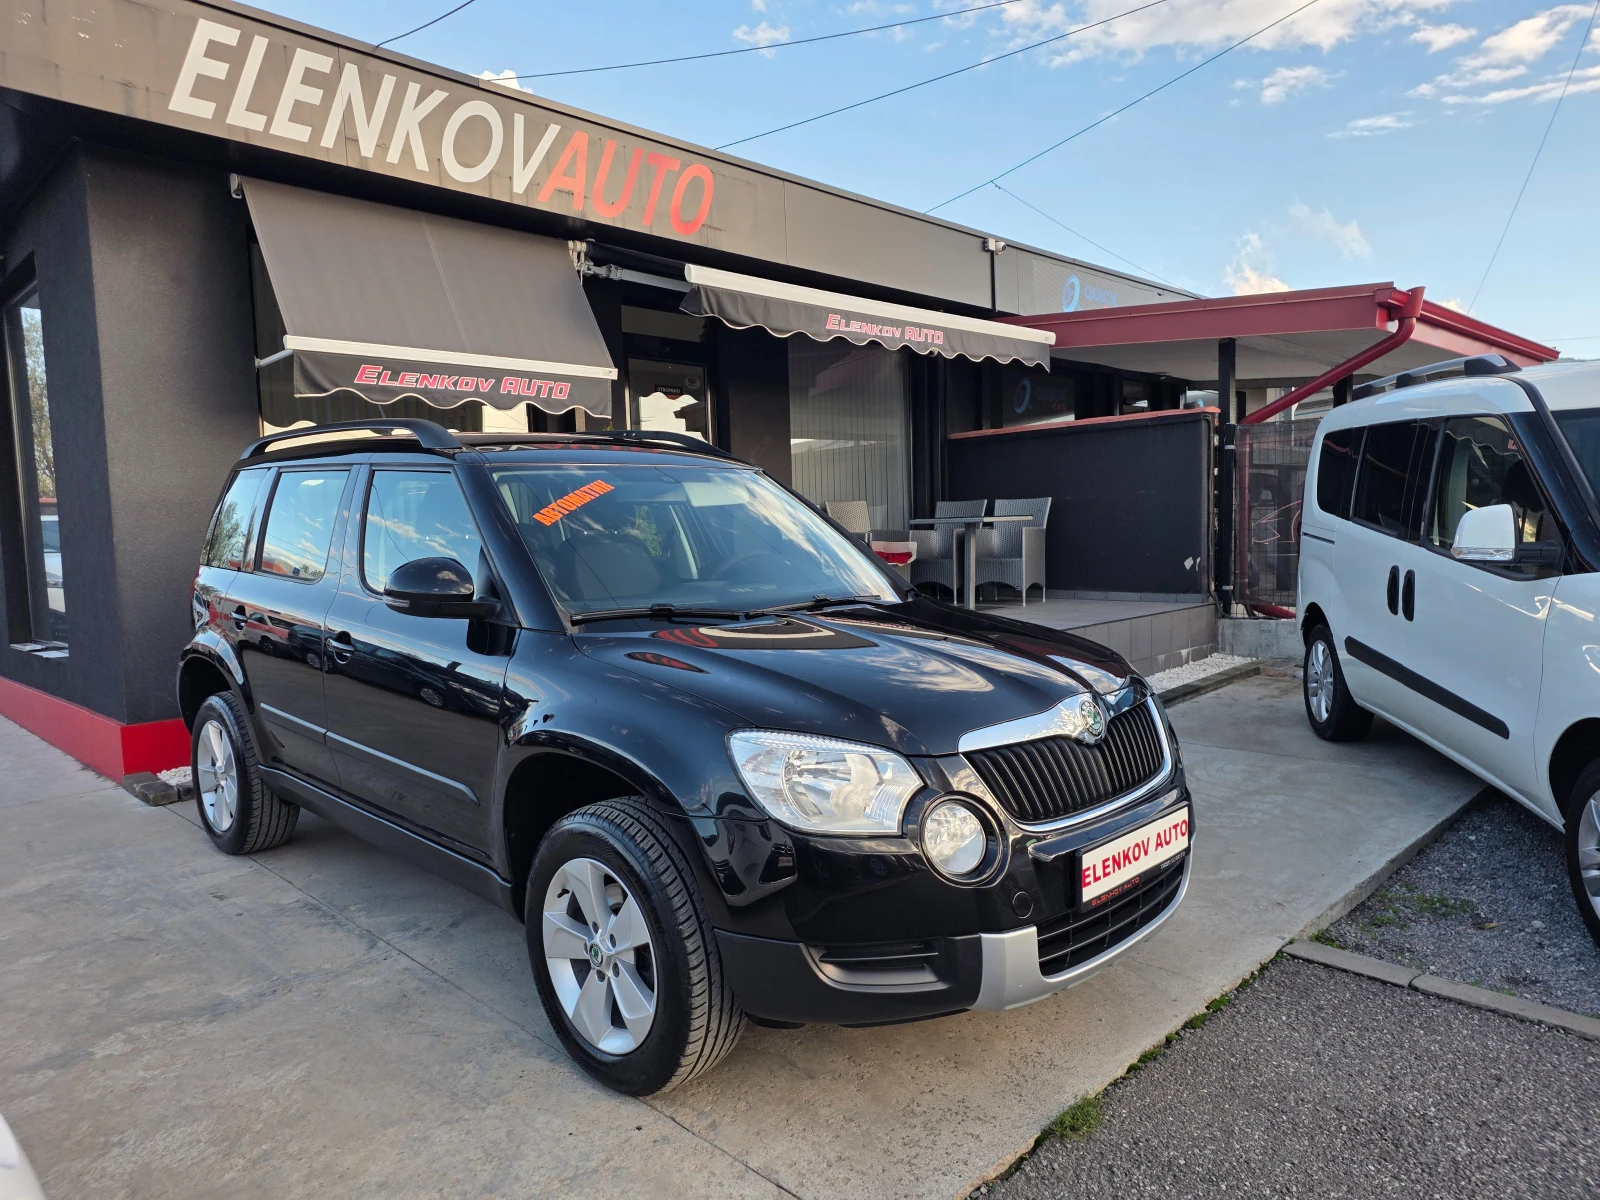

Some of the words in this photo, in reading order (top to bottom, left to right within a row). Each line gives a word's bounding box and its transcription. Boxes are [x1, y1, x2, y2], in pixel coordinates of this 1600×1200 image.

[1083, 285, 1118, 307] QUICK
[826, 314, 902, 338] ELENKOV
[904, 326, 944, 345] AUTO
[354, 364, 495, 393] ELENKOV
[500, 376, 571, 400] AUTO
[1082, 837, 1150, 889] ELENKOV
[1155, 819, 1188, 852] AUTO
[1124, 877, 1140, 889] AUTO
